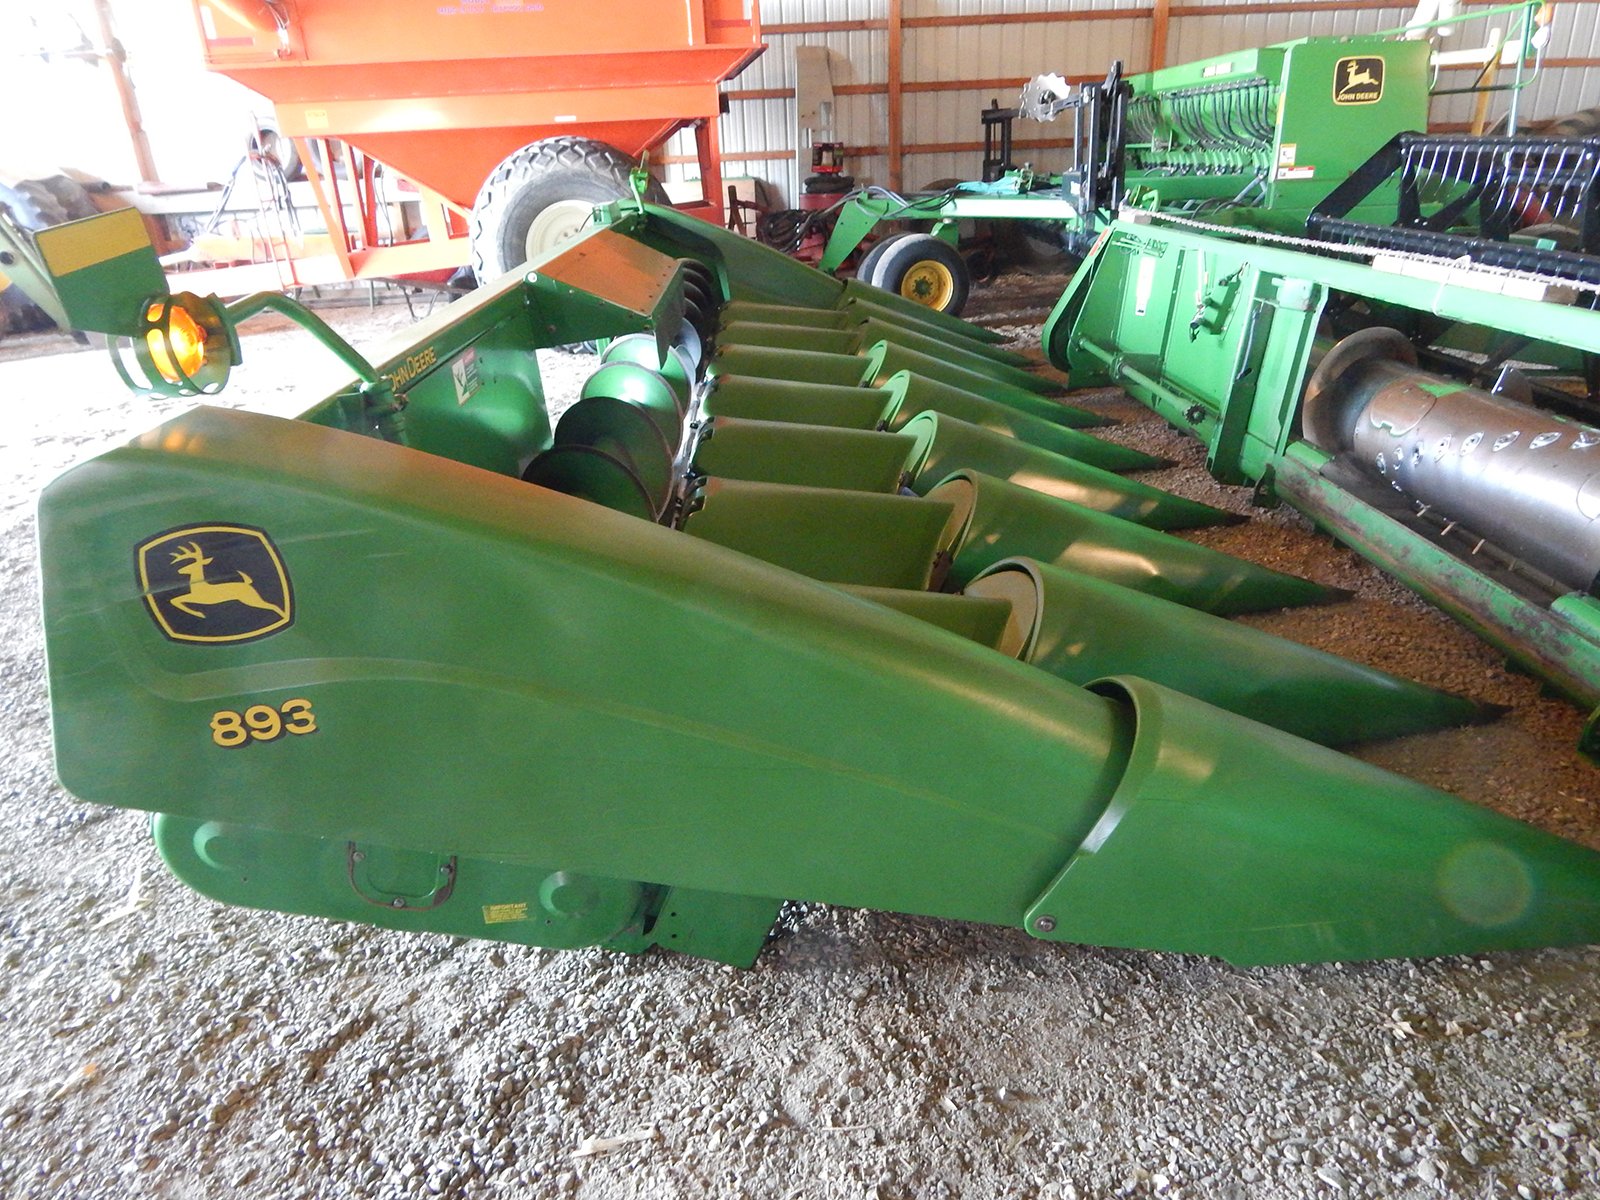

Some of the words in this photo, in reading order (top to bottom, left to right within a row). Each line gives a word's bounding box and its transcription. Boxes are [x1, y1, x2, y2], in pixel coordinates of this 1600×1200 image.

[1337, 93, 1356, 101] JOHN
[1356, 91, 1379, 100] DEERE
[406, 346, 437, 379] DEERE
[209, 698, 318, 748] 893
